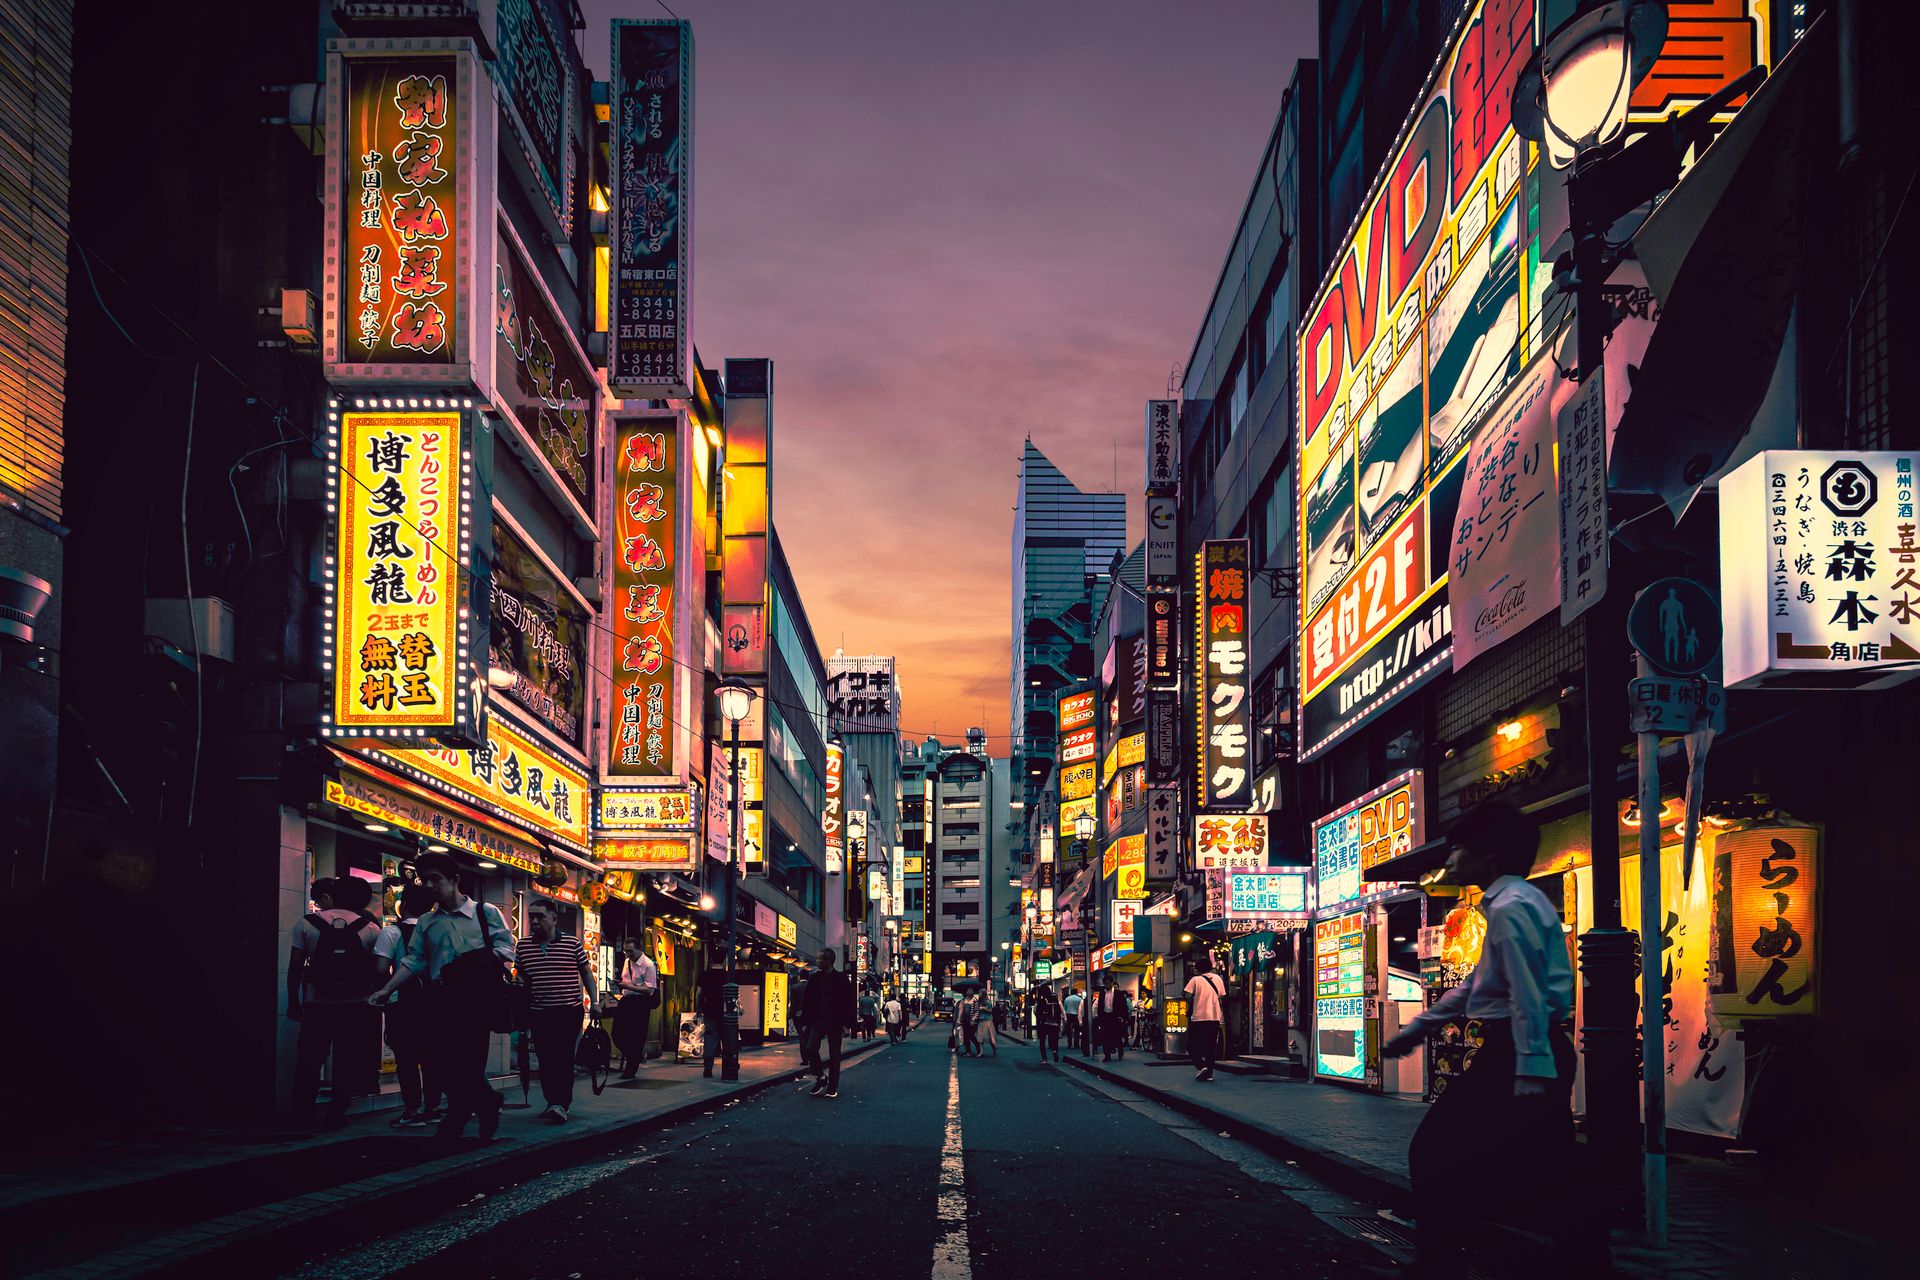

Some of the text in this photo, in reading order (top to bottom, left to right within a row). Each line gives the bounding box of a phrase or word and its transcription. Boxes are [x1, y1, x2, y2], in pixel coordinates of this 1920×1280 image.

[361, 149, 382, 230] 中国料理
[620, 269, 677, 280] 新宿東口店
[619, 324, 676, 339] 五反田店
[1479, 432, 1520, 496] 渋谷
[1457, 442, 1539, 546] おとなり
[1573, 401, 1592, 600] 防犯カメラ作動中
[1896, 457, 1913, 518] 信州の酒
[364, 430, 414, 606] 博多風龍
[416, 432, 440, 606] とんこつらーめん
[1456, 490, 1545, 578] サンデー
[1832, 520, 1868, 537] 渋谷
[1824, 540, 1880, 631] 森本
[1888, 522, 1920, 624] 喜久水
[1313, 522, 1414, 680] 受付2F
[367, 613, 429, 632] 2玉まで
[1830, 642, 1881, 661] 角店
[827, 671, 890, 691] イワキ
[1208, 567, 1247, 800] 焼肉 モクモク
[827, 697, 892, 716] メガネ
[1063, 697, 1094, 711] カラオケ
[621, 684, 640, 766] 中国料理
[1063, 731, 1094, 746] カラオケ
[468, 738, 573, 825] 博多風龍
[1064, 768, 1093, 783] 腹八分目
[605, 805, 657, 818] 博多風龍
[824, 755, 841, 834] カラオケ
[1320, 819, 1347, 852] 金太郎
[1361, 790, 1410, 847] DVD
[1219, 857, 1259, 867] 道玄坂店
[1320, 841, 1358, 876] 渋谷書店
[1234, 878, 1266, 892] 金太郎
[1234, 894, 1278, 909] 渋谷書店
[1167, 1001, 1178, 1026] 焼肉
